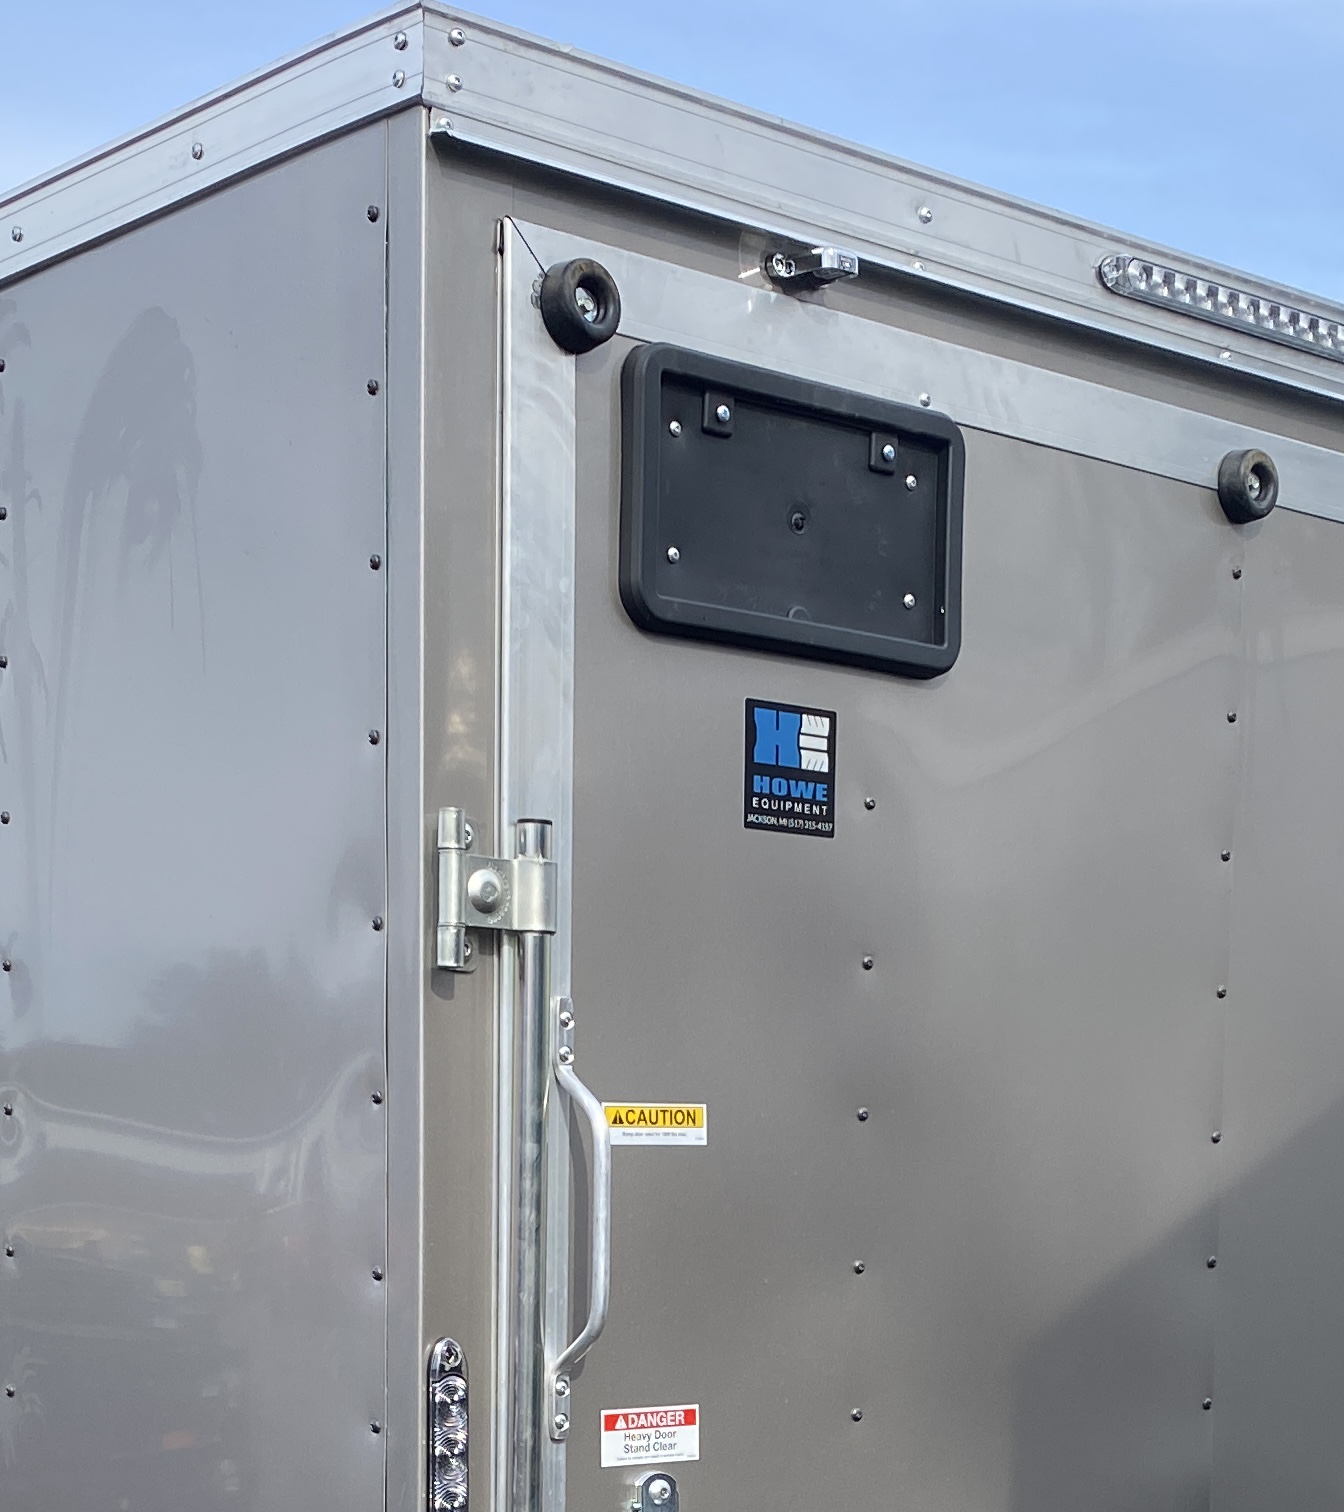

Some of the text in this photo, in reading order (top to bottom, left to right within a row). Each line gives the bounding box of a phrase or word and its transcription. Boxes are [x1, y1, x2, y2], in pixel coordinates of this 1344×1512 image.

[753, 774, 828, 802] HOWE
[752, 797, 828, 816] EQUIPMENT
[625, 1109, 696, 1126] CAUTION
[627, 1411, 686, 1429] DANGER
[623, 1429, 677, 1442] Heavy Door
[623, 1441, 678, 1454] Stand Clear
